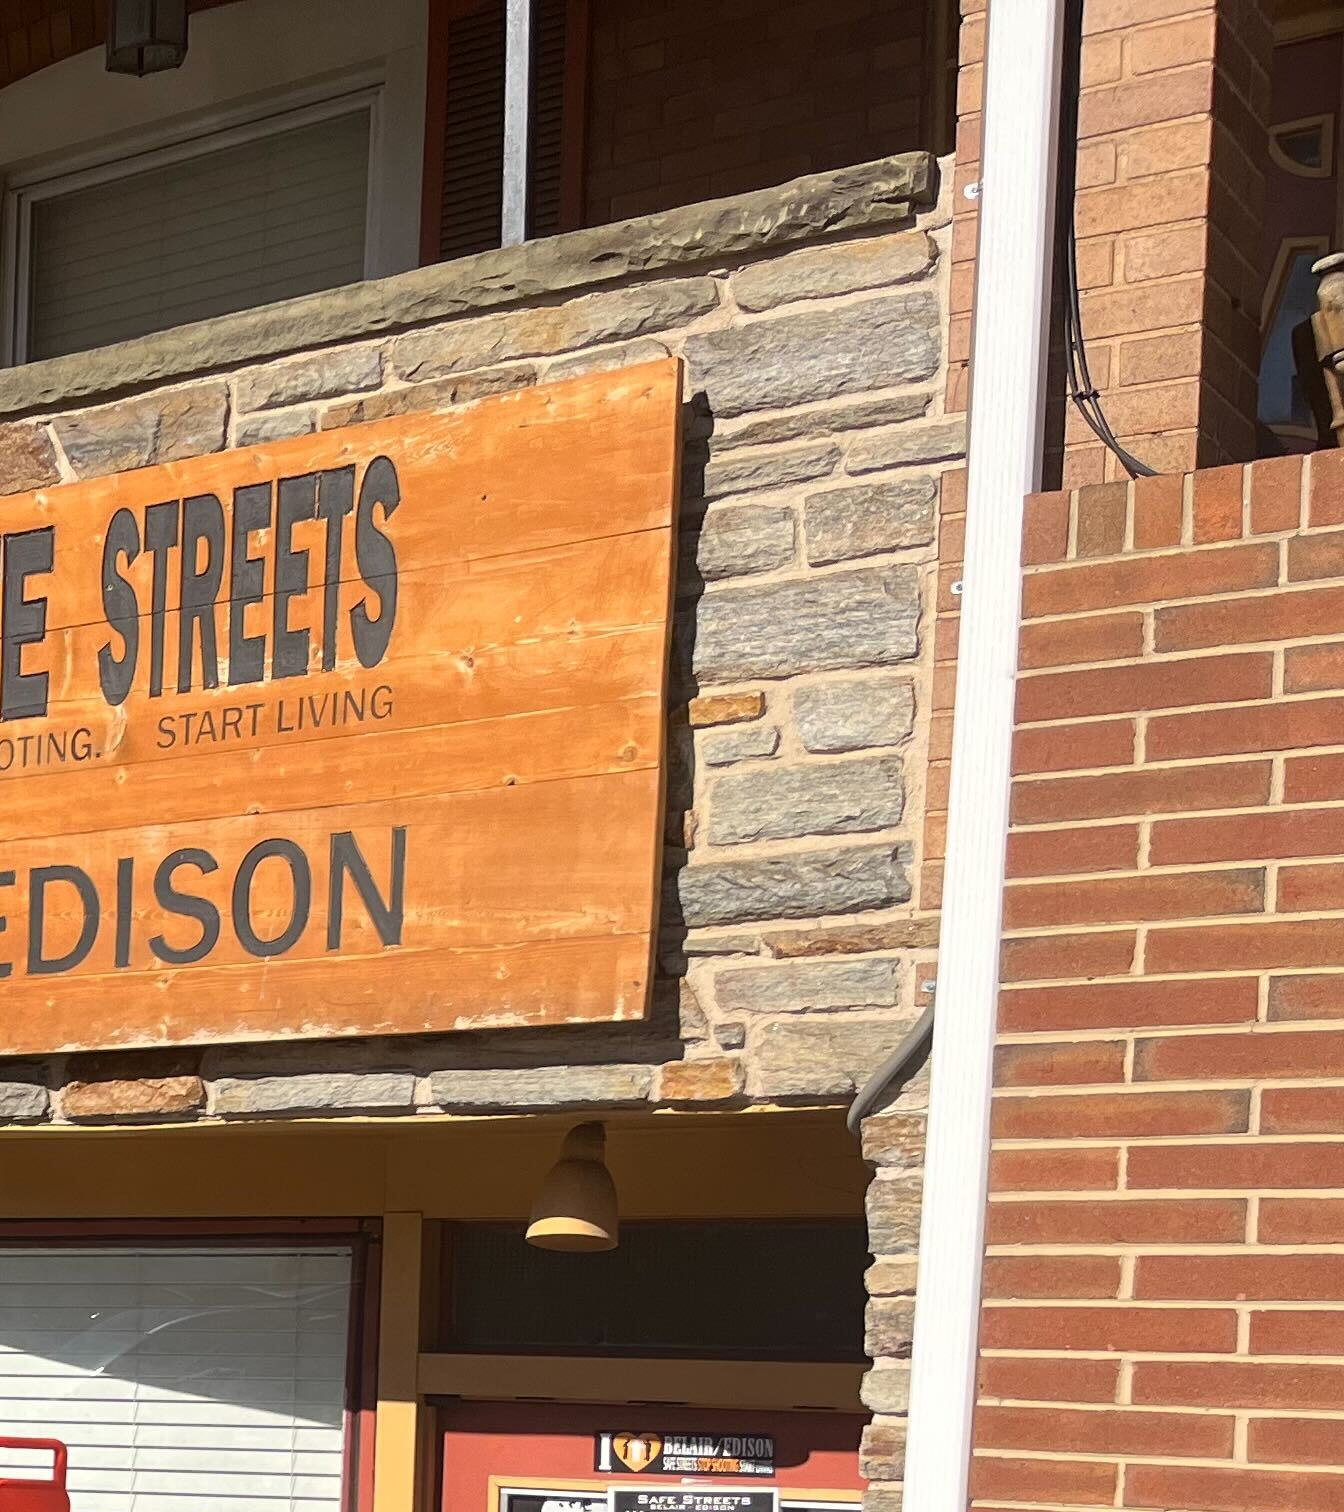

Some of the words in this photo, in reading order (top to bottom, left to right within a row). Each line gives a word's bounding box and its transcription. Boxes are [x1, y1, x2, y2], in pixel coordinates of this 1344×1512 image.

[98, 455, 400, 707] STREETS
[156, 700, 271, 750] START
[276, 685, 394, 739] LIVING
[637, 1494, 677, 1504] SAFE
[682, 1495, 751, 1506] STREETS
